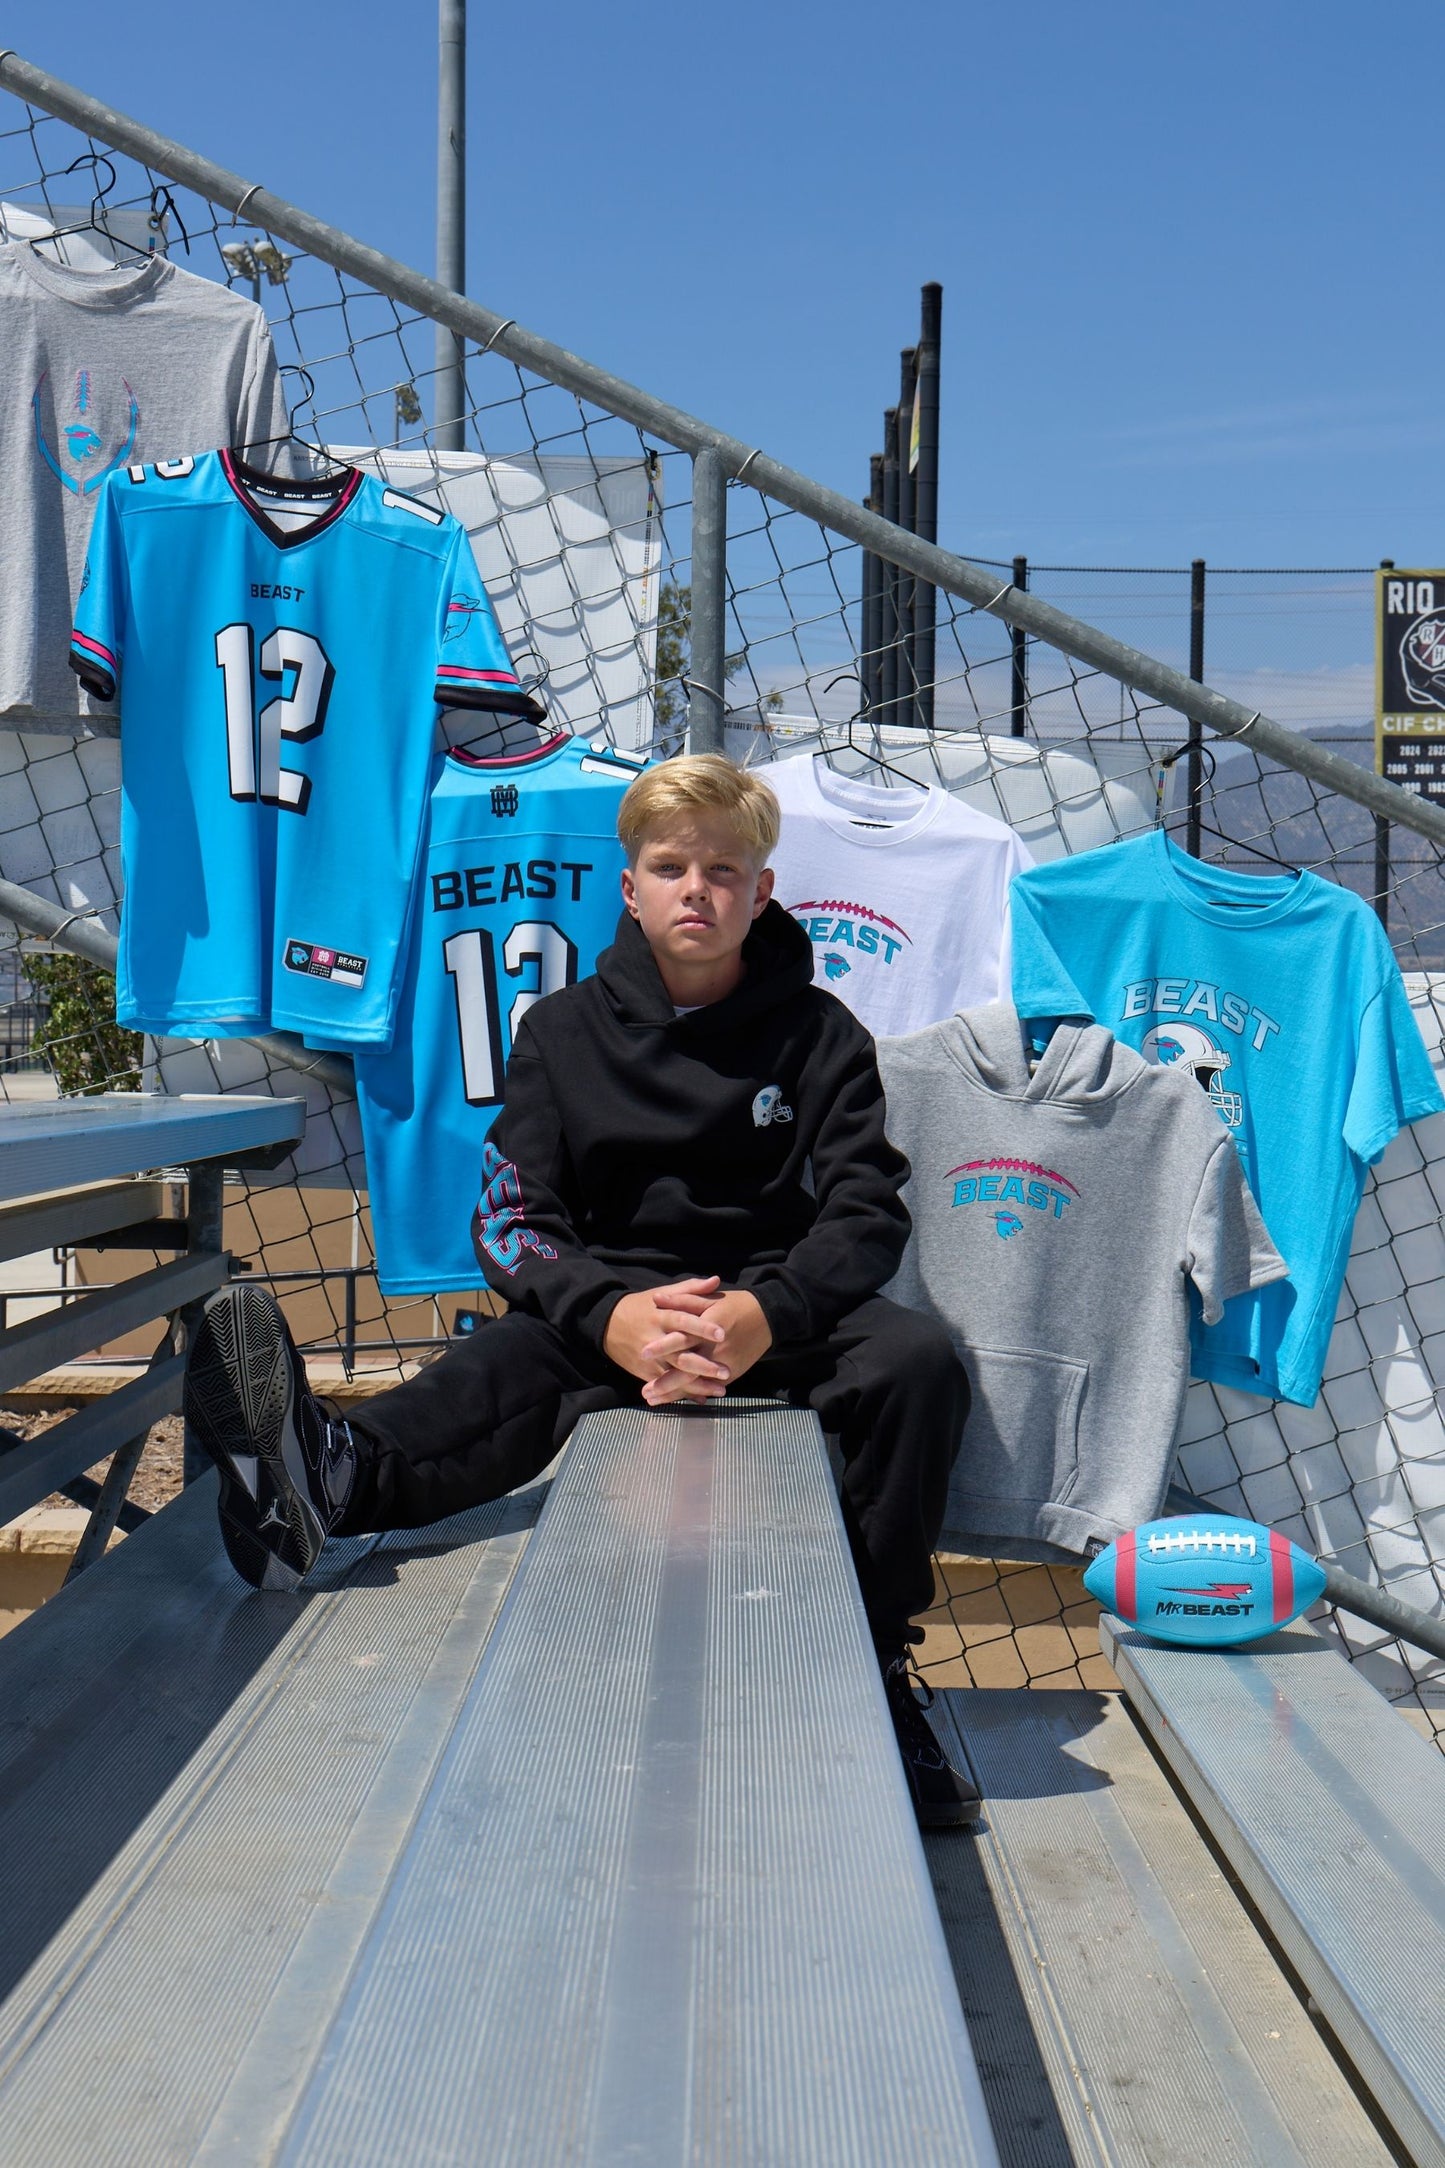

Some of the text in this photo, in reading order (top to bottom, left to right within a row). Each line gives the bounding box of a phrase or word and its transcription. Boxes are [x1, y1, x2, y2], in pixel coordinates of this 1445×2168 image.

[284, 492, 305, 500] BEAST
[312, 491, 333, 499] BEAST
[250, 583, 305, 602] BEAST
[1387, 580, 1434, 614] RIO
[214, 622, 337, 817] 12
[1428, 745, 1445, 757] 202
[430, 860, 594, 913] BEAST
[337, 956, 363, 968] BEAST
[442, 919, 579, 1108] 12
[1120, 977, 1281, 1052] BEAST
[951, 1175, 1072, 1219] BEAST
